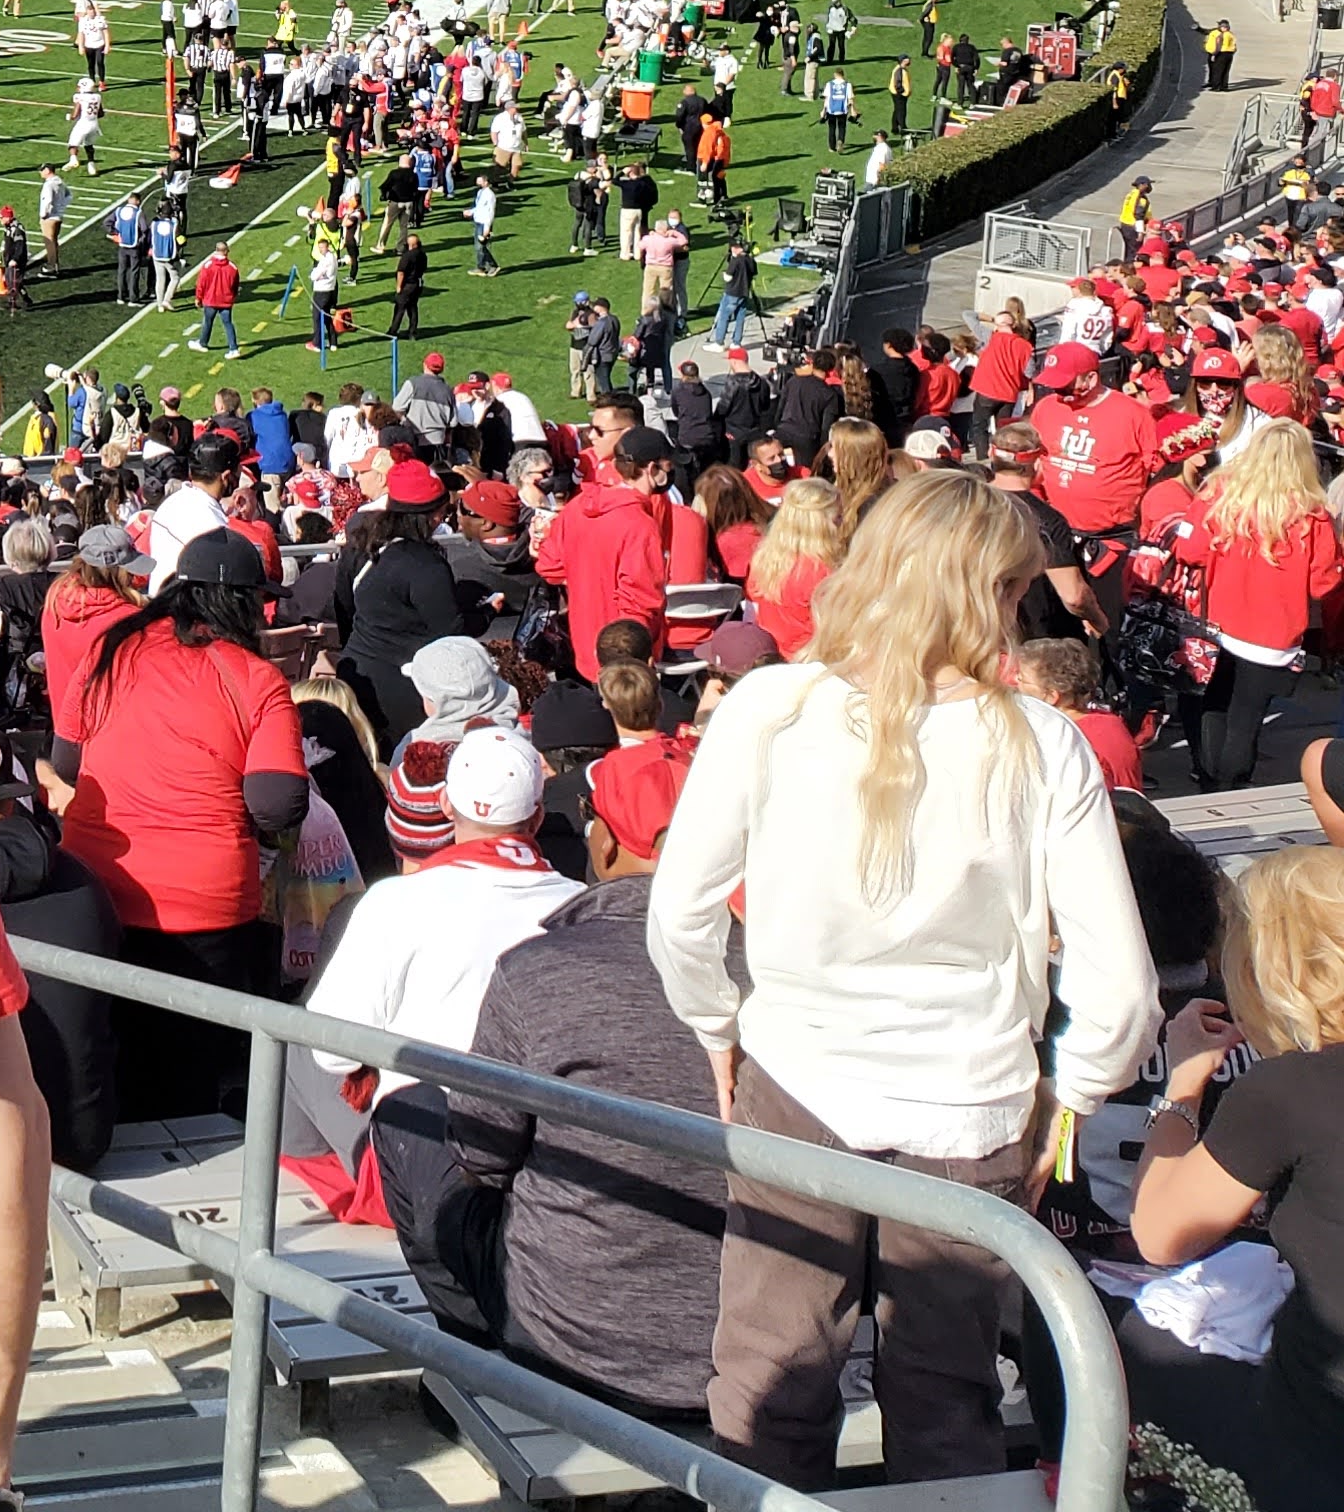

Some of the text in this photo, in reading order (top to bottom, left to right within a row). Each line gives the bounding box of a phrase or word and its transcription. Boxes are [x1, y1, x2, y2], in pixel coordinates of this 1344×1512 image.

[980, 275, 991, 290] 2
[1081, 318, 1106, 340] 92
[474, 800, 492, 817] U
